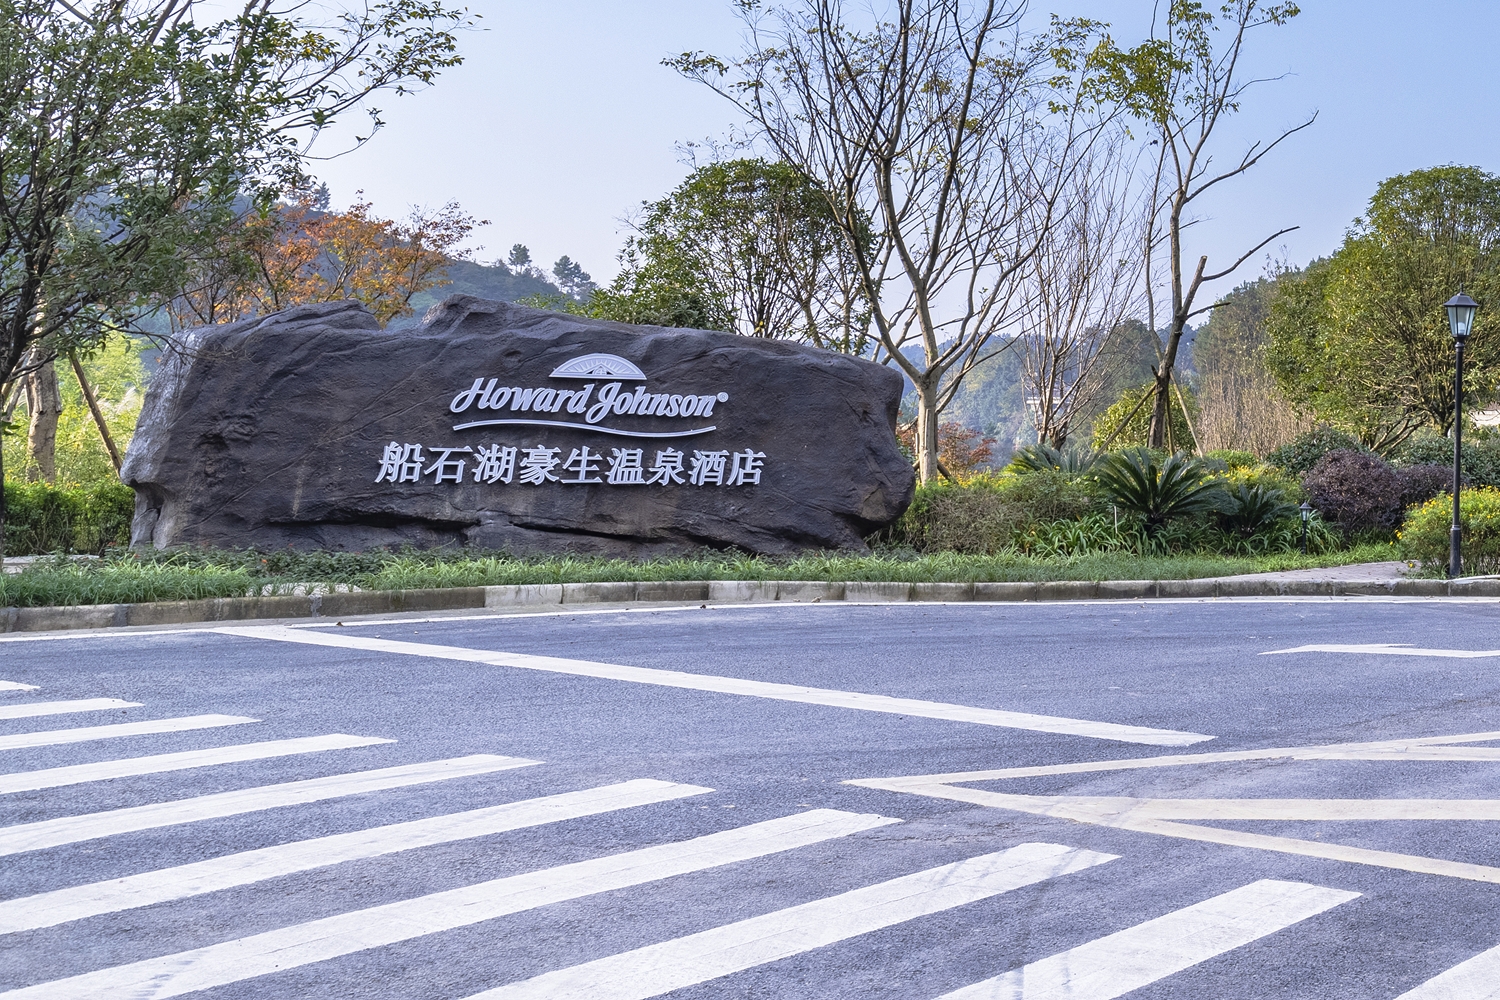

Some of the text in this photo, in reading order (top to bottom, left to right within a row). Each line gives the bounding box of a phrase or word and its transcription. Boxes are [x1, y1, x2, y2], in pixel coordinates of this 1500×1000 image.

[450, 377, 595, 414] Howard
[375, 441, 765, 486] 船石湖豪生温泉酒店
